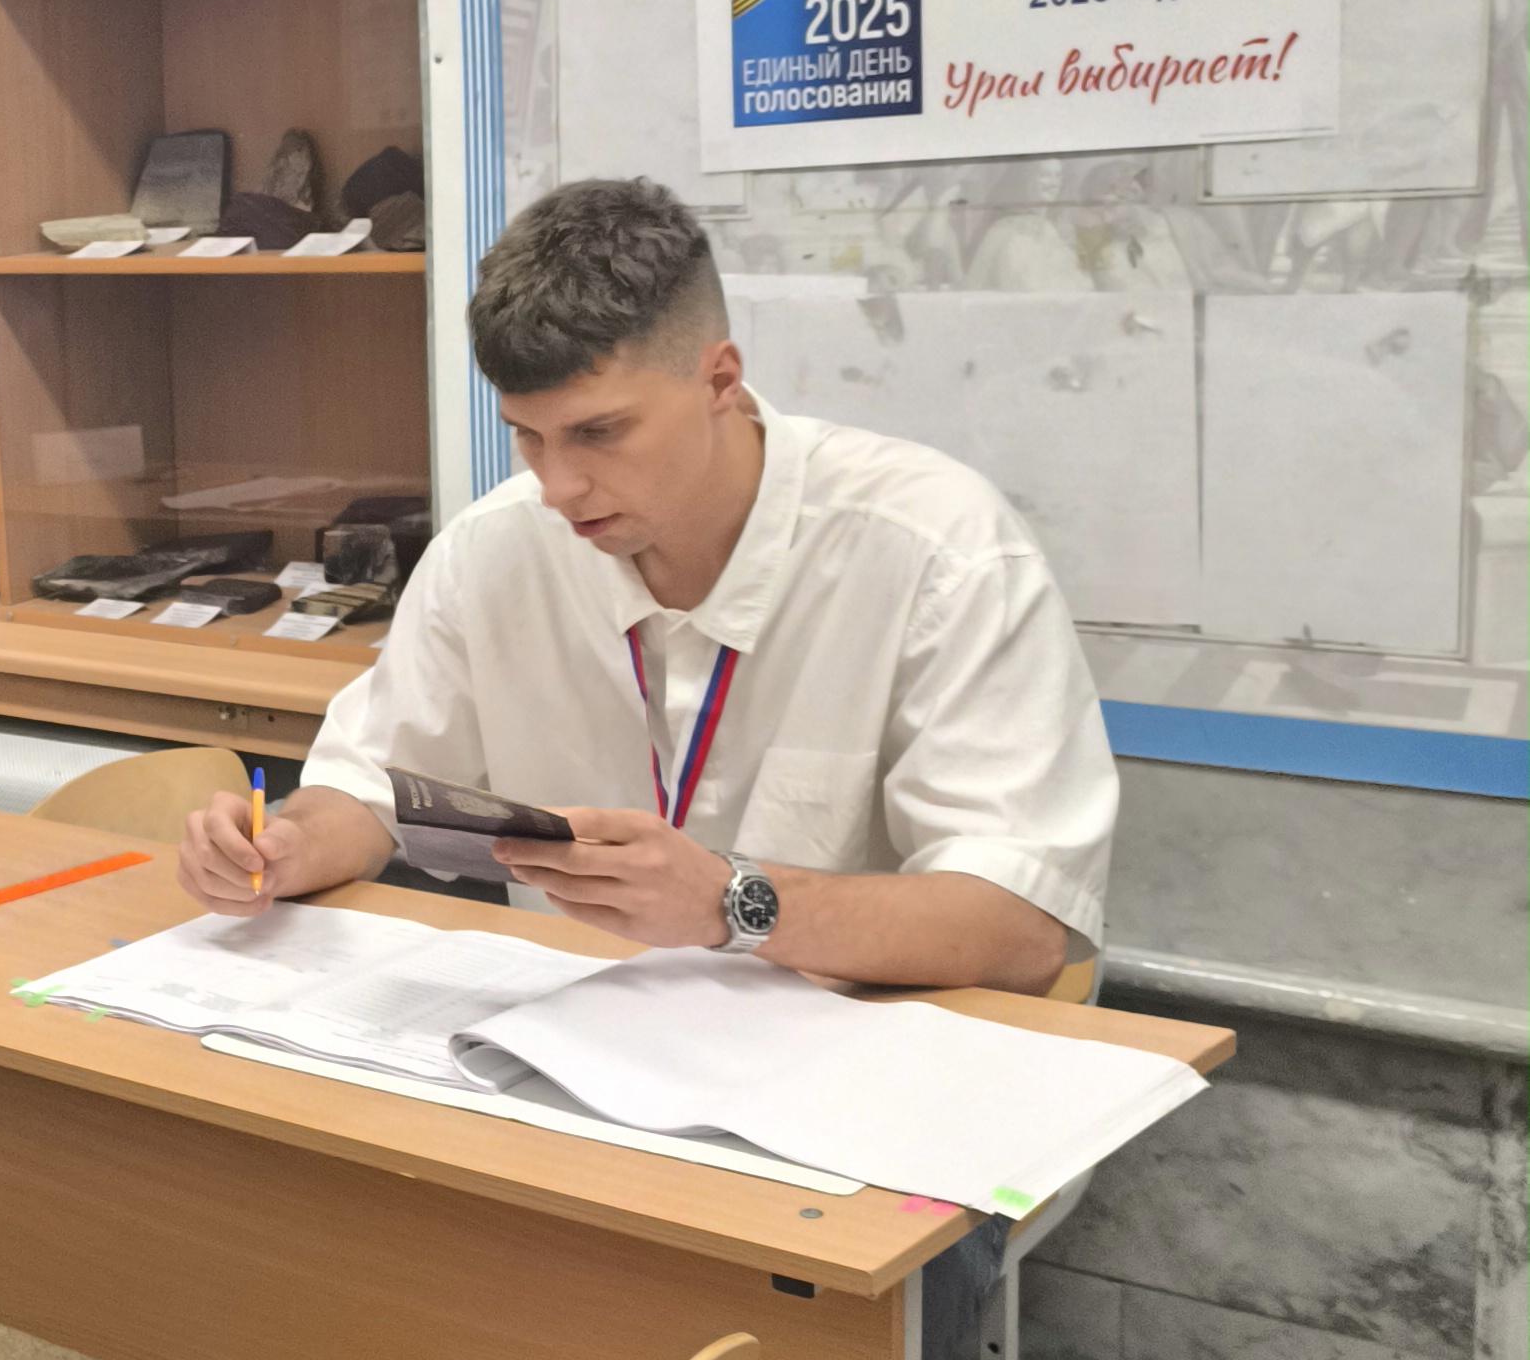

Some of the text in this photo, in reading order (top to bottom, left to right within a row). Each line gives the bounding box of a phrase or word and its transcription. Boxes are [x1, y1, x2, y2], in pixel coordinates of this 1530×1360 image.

[742, 46, 913, 88] ЕДИНЫЙ ДЕНЬ
[944, 31, 1299, 118] Урал выбирает!
[743, 78, 913, 115] голосования
